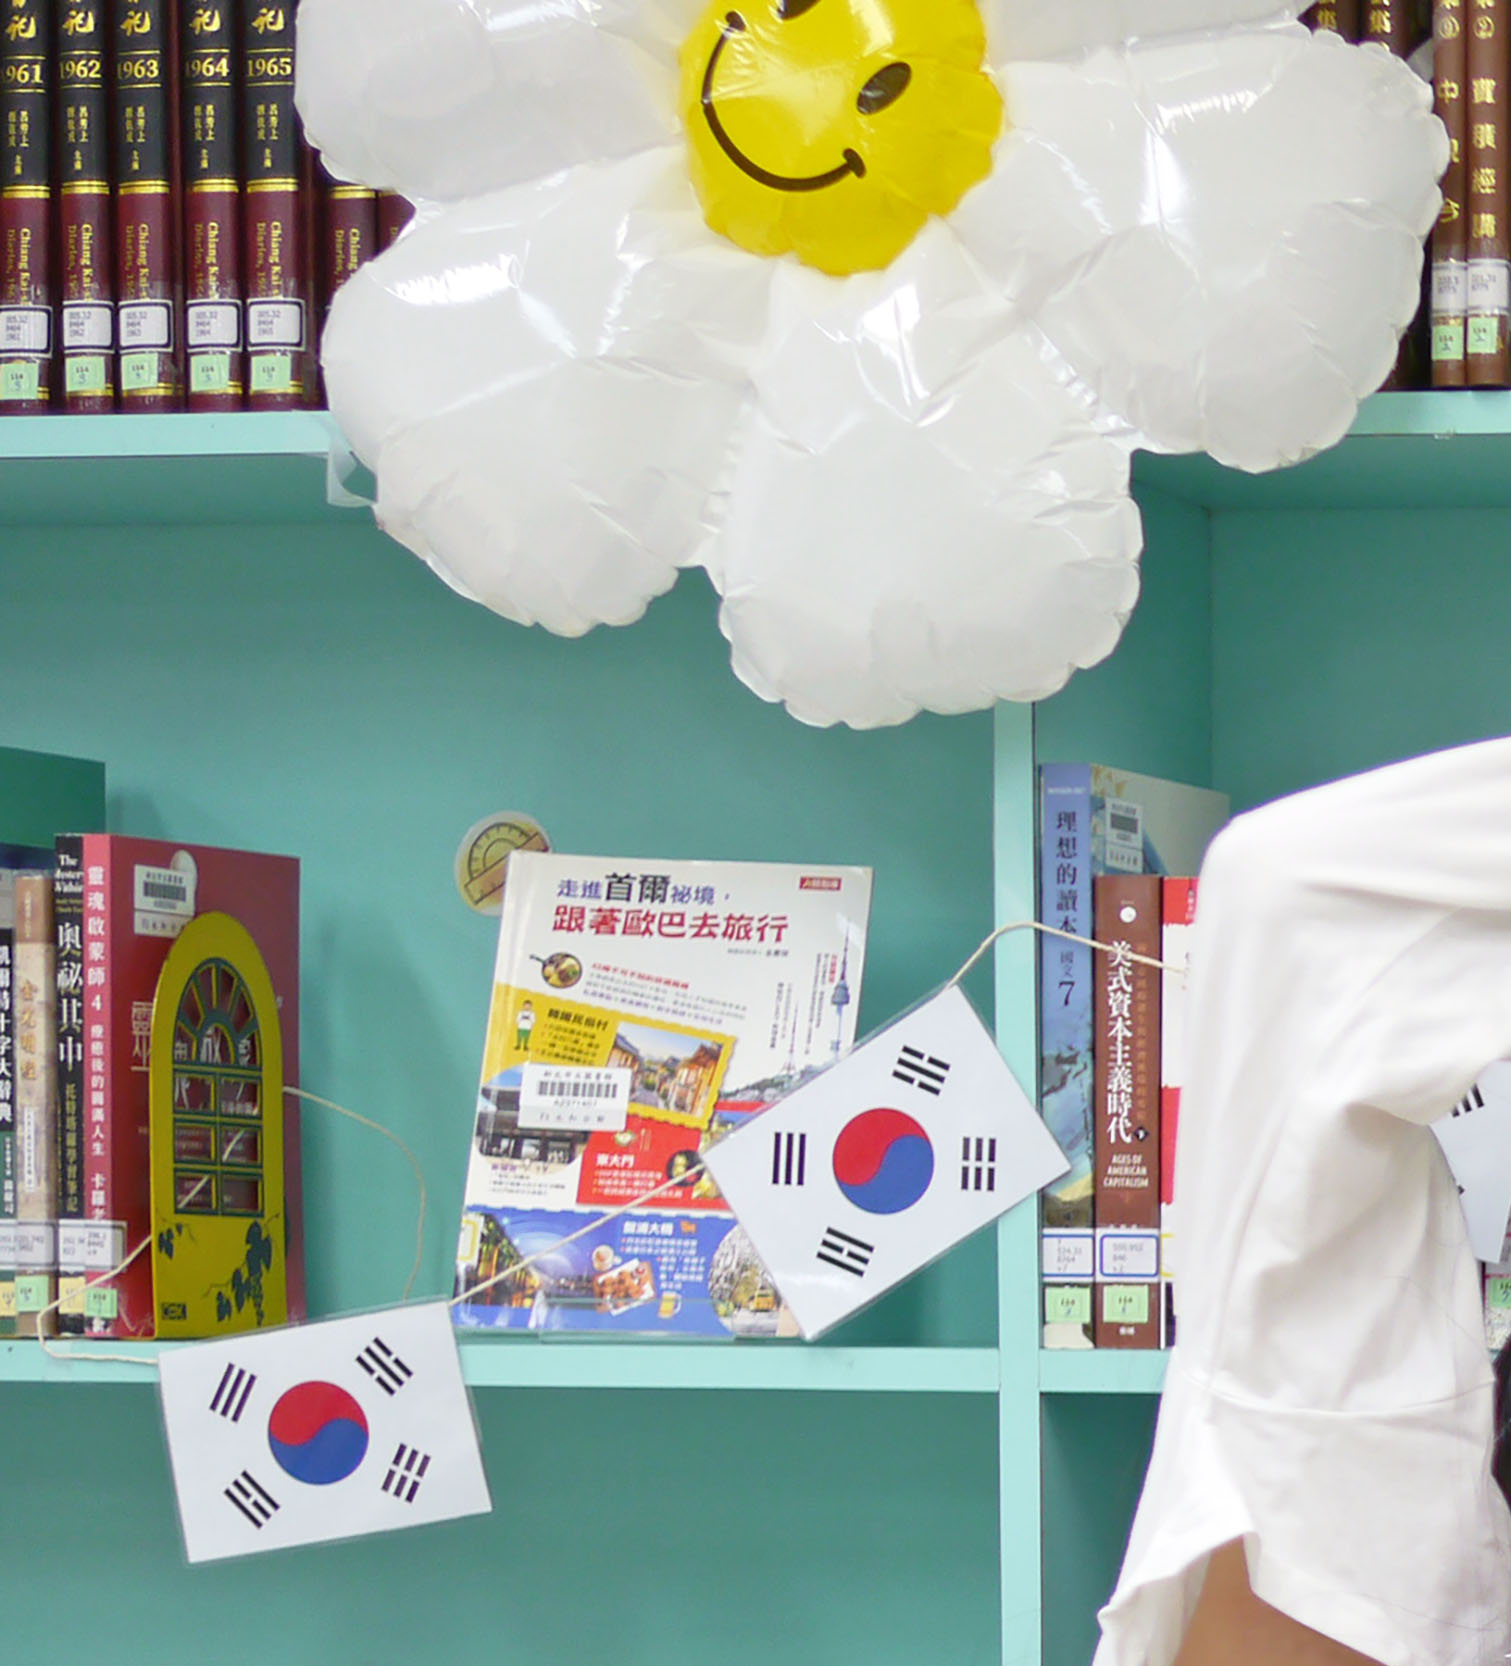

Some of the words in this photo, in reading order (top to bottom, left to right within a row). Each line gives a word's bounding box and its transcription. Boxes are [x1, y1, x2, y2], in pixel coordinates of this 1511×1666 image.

[3, 64, 43, 84] 961
[60, 60, 101, 79] 1962
[118, 60, 159, 79] 1963
[186, 57, 229, 78] 1964
[248, 57, 292, 77] 1965
[19, 228, 31, 269] Chiang
[81, 223, 93, 265] Chiang
[137, 223, 149, 265] Chiang
[206, 222, 219, 264] Chiang
[269, 221, 282, 263] Chiang
[1056, 810, 1078, 934] 理想的讀本
[552, 904, 789, 944] 跟著歐巴去旅行
[1058, 980, 1075, 1008] 7
[1107, 940, 1134, 1144] 美式資本主義時代
[1103, 1176, 1149, 1188] CAPITALISM
[1107, 1165, 1147, 1176] AMERICAN
